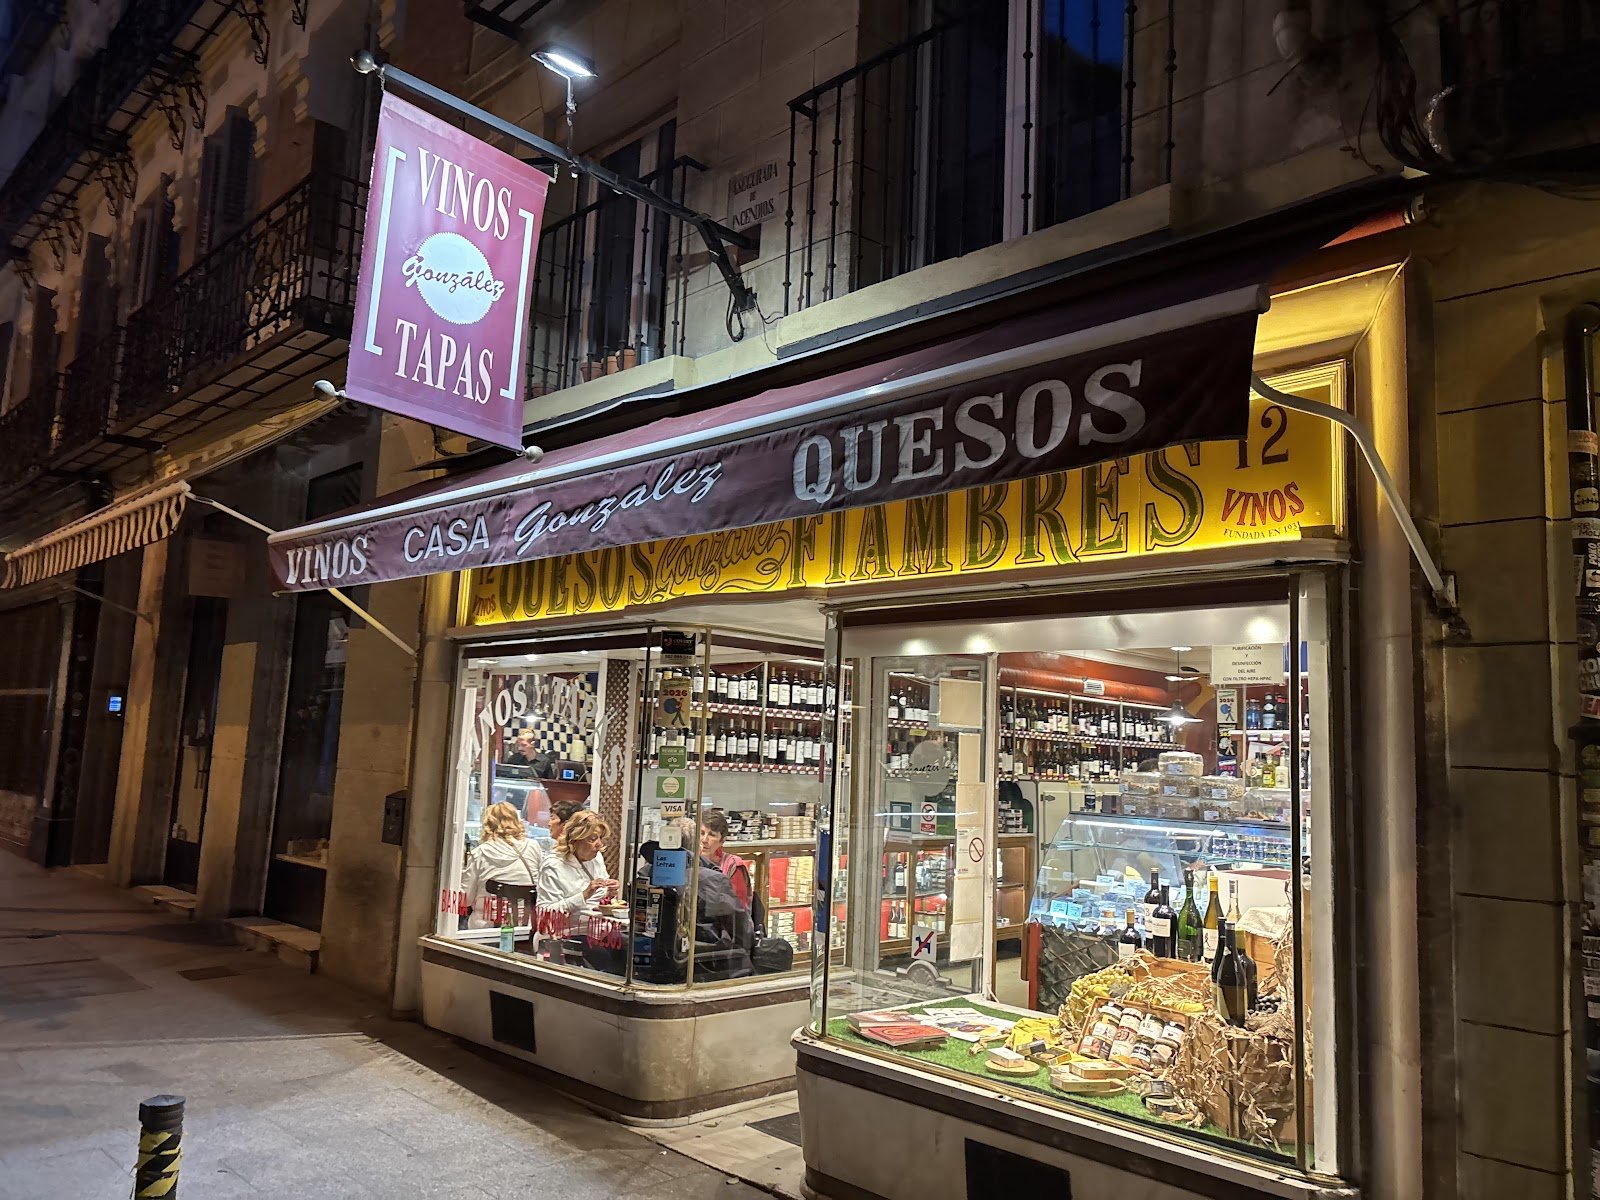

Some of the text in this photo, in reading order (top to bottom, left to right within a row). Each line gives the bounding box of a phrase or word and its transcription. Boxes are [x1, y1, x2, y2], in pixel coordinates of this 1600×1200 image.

[417, 146, 512, 241] VINOS
[395, 318, 494, 404] TAPAS
[286, 358, 1146, 585] VINOS CASA Gonzalez QUESOS
[1221, 481, 1304, 527] VINOS
[786, 441, 1204, 589] FIAMBRES
[1223, 528, 1265, 540] FUNDADA
[1268, 527, 1281, 538] EN
[662, 689, 688, 697] 2026
